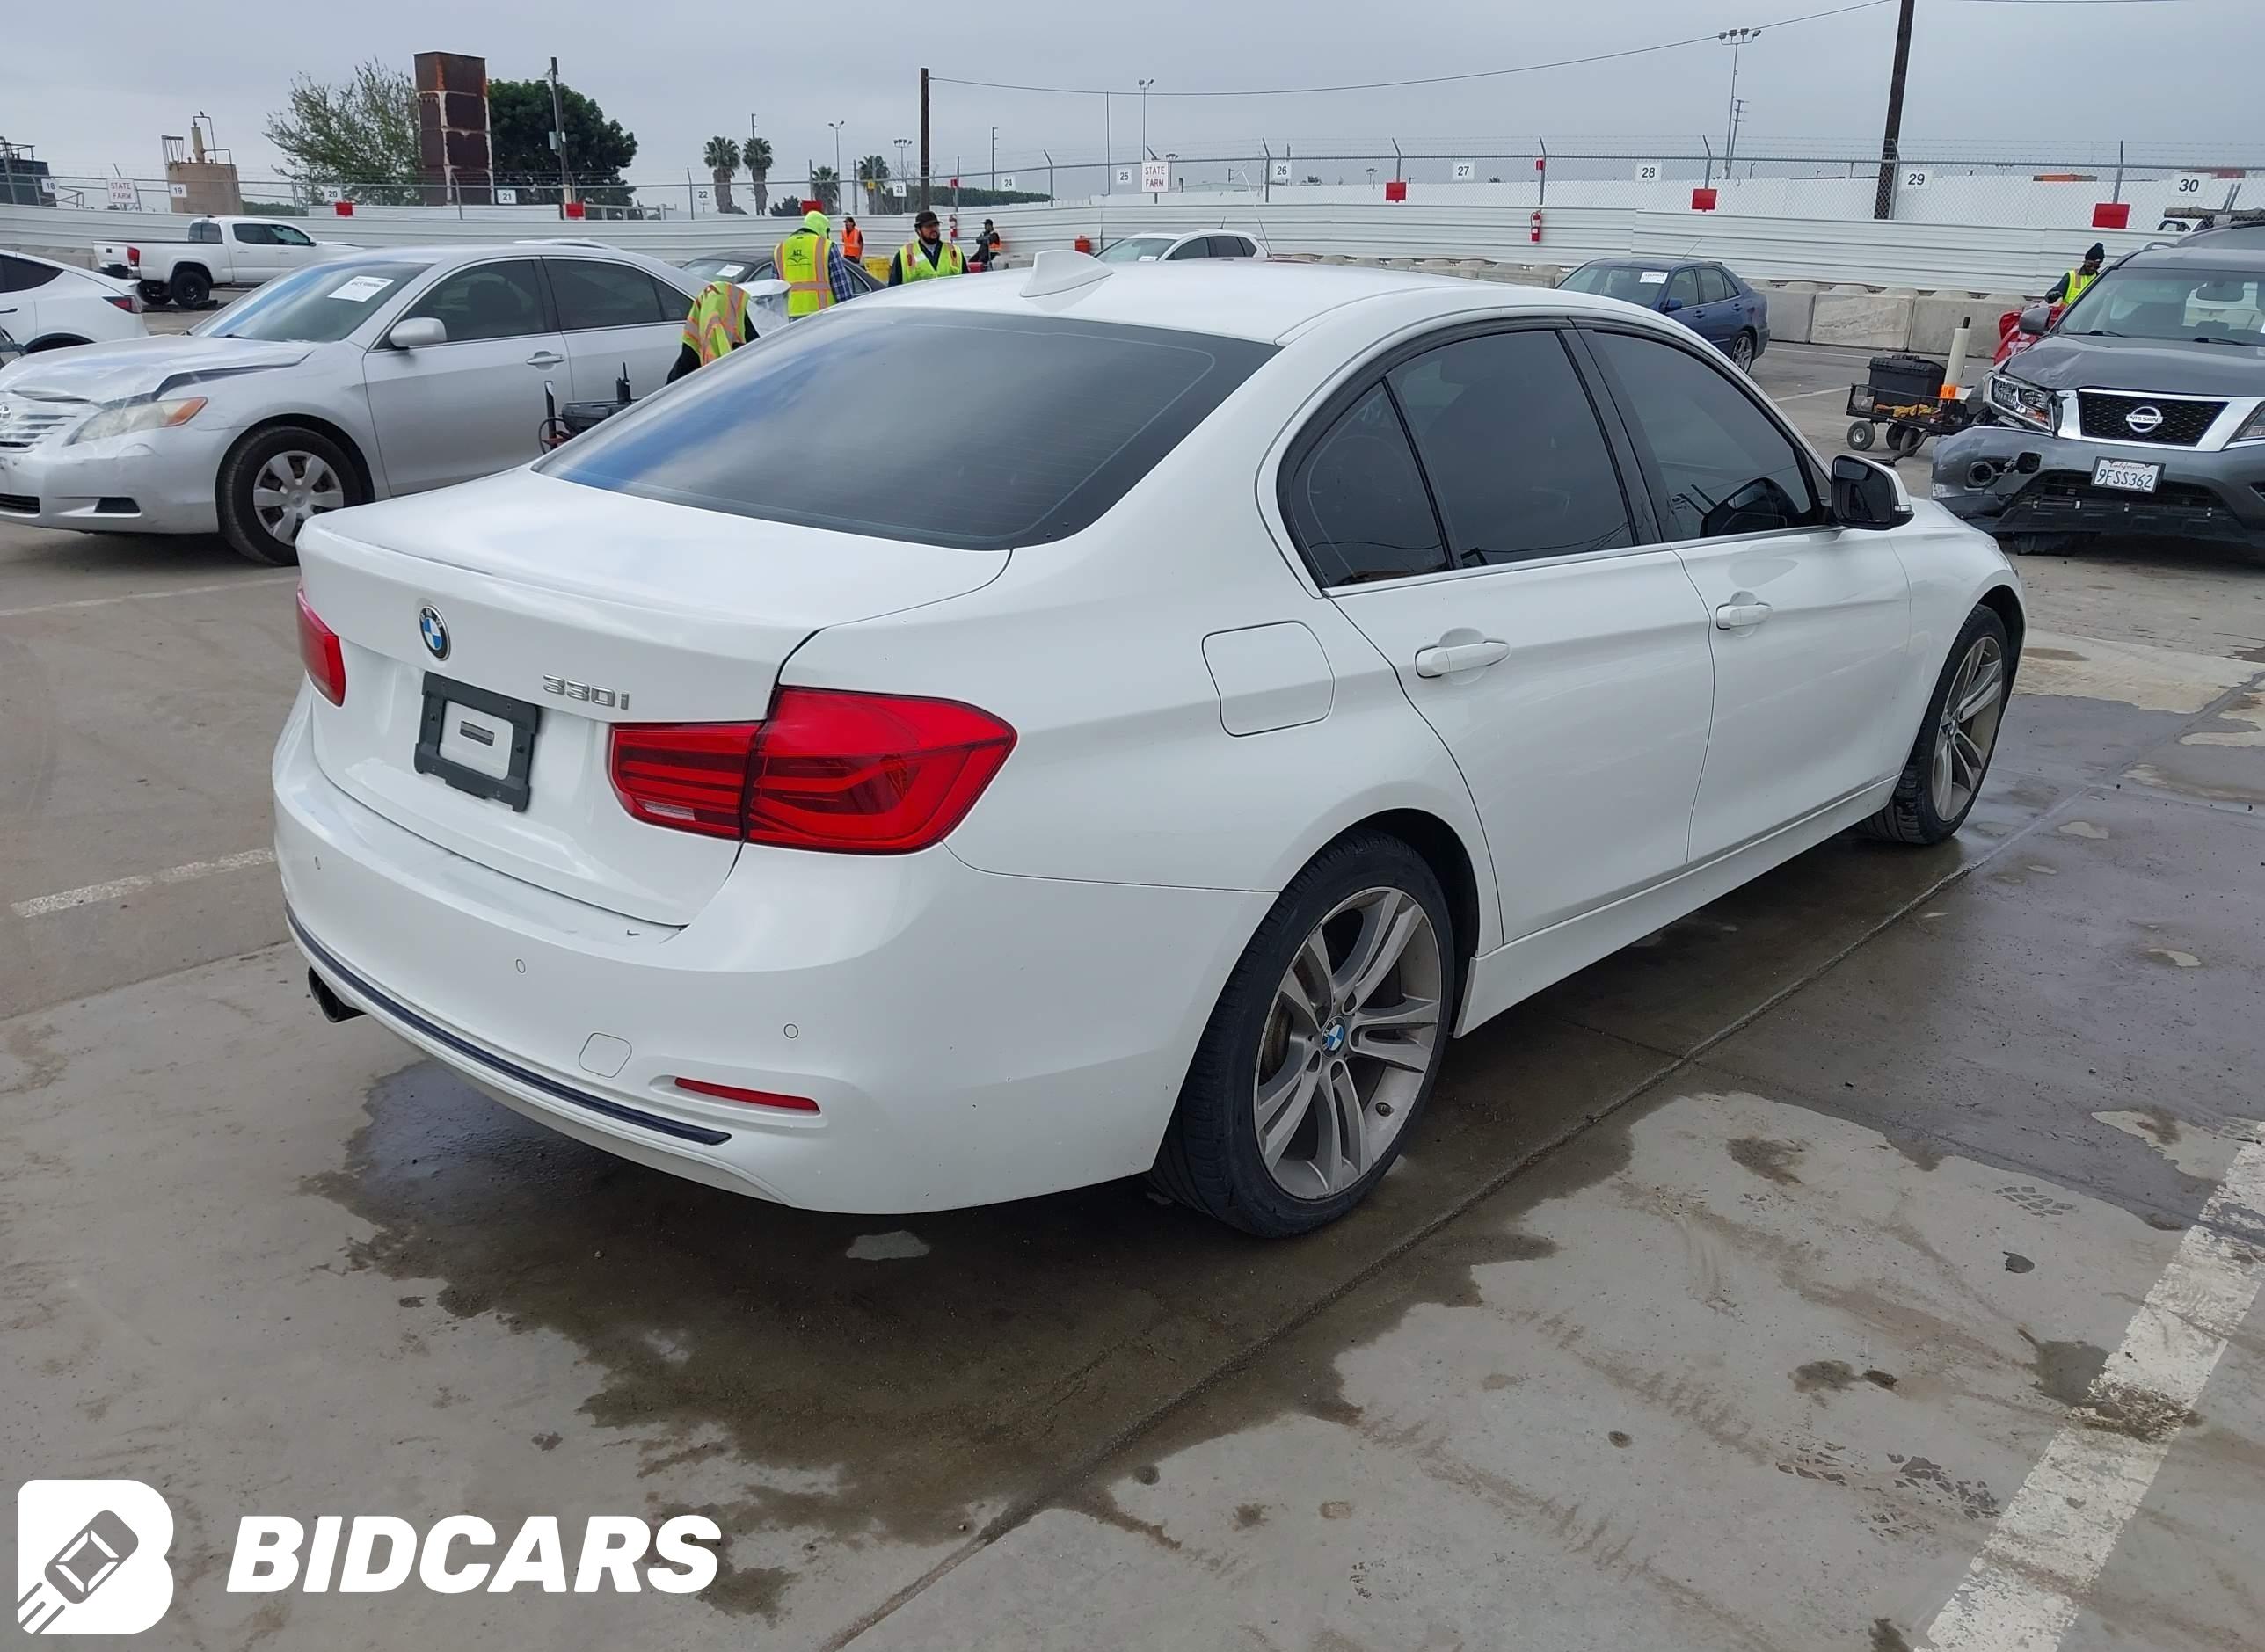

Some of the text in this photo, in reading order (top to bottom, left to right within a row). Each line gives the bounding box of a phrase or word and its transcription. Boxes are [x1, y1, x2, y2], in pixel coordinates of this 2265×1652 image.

[1145, 166, 1165, 175] STATE
[1277, 165, 1287, 176] 26
[1457, 166, 1470, 176] 27
[1641, 167, 1656, 178] 28
[1119, 171, 1129, 181] 25
[1907, 173, 1926, 186] 29
[1004, 178, 1013, 187] 24
[1146, 178, 1164, 187] FARM
[2178, 178, 2200, 193] 30
[895, 185, 904, 193] 23
[2096, 469, 2153, 489] 9FSS362
